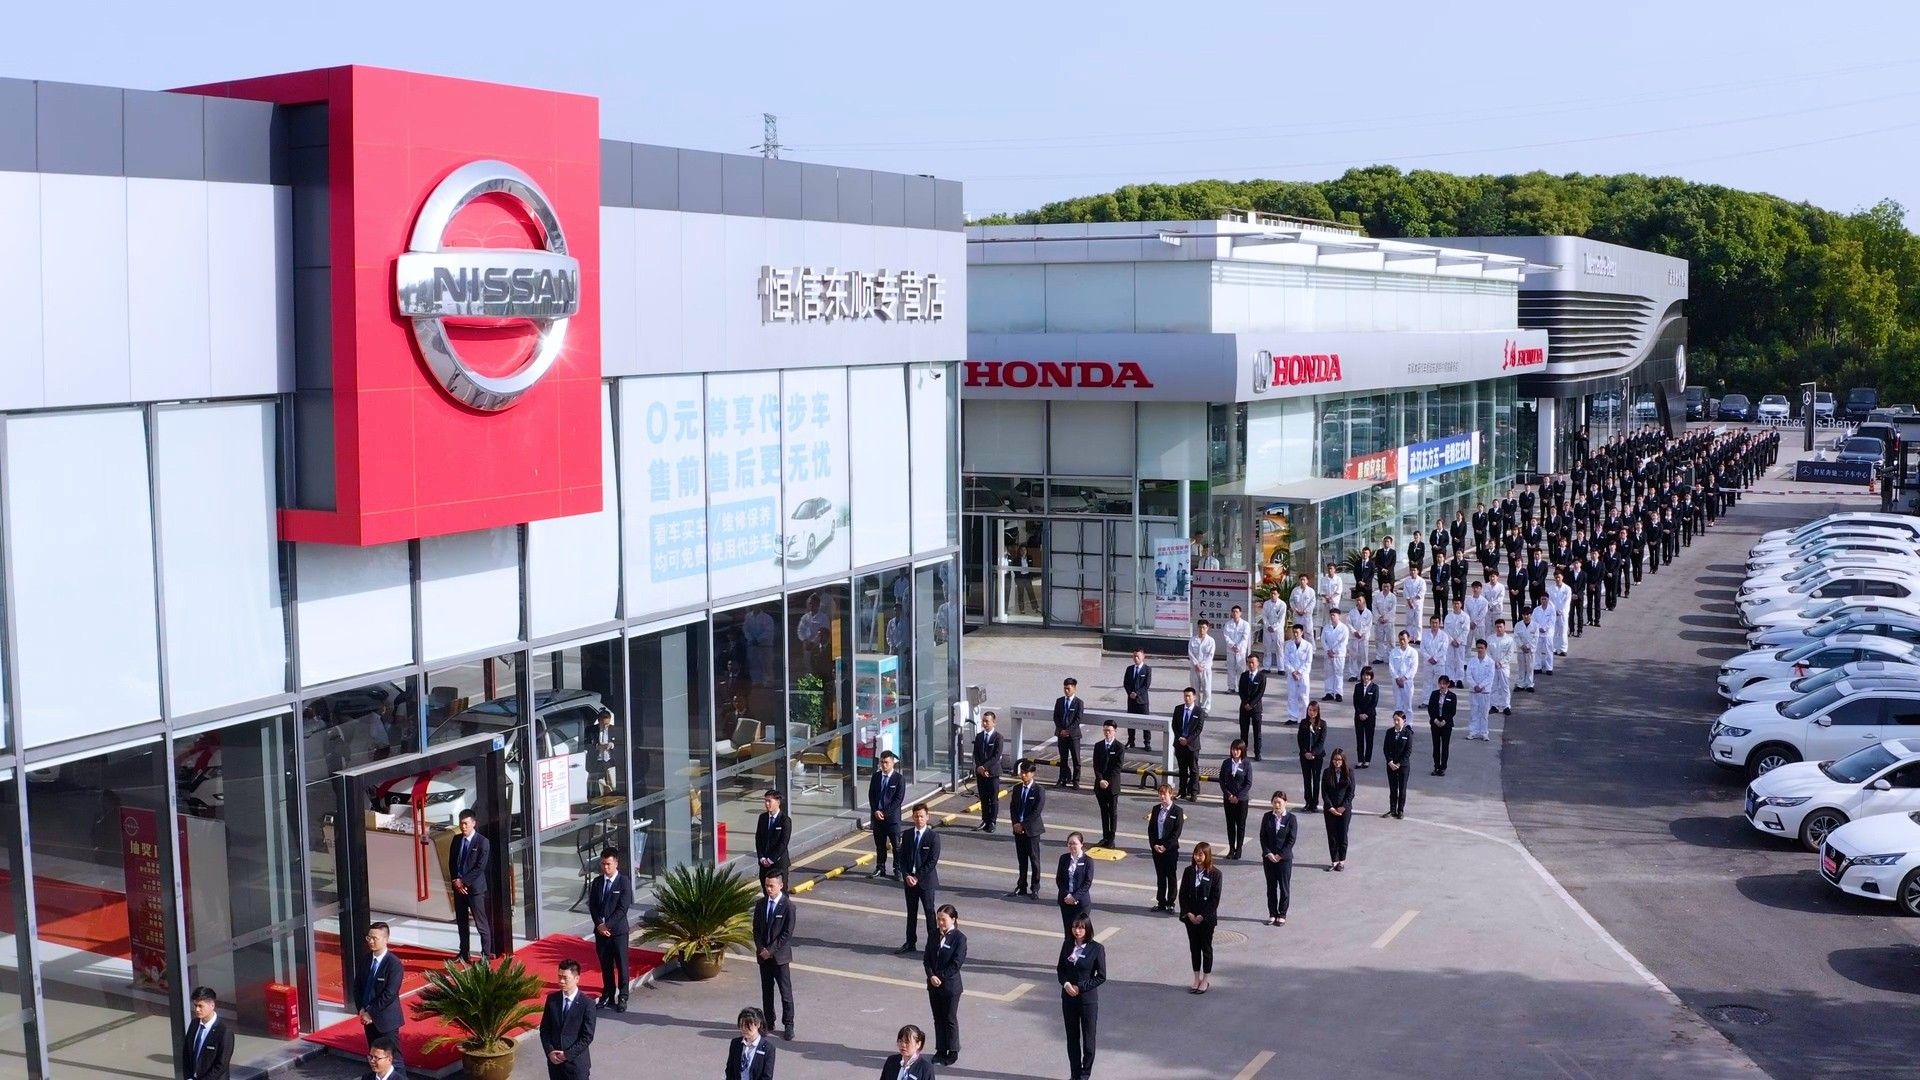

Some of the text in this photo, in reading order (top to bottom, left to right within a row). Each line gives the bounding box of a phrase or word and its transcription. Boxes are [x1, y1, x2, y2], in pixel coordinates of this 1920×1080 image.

[433, 266, 576, 304] NISSAN
[762, 265, 947, 322] 恒信东顺专营店
[964, 360, 1154, 388] HONDA
[1271, 353, 1343, 387] HONDA
[1759, 415, 1859, 430] Merces-Benz
[648, 440, 832, 502] 售前售后更无忧
